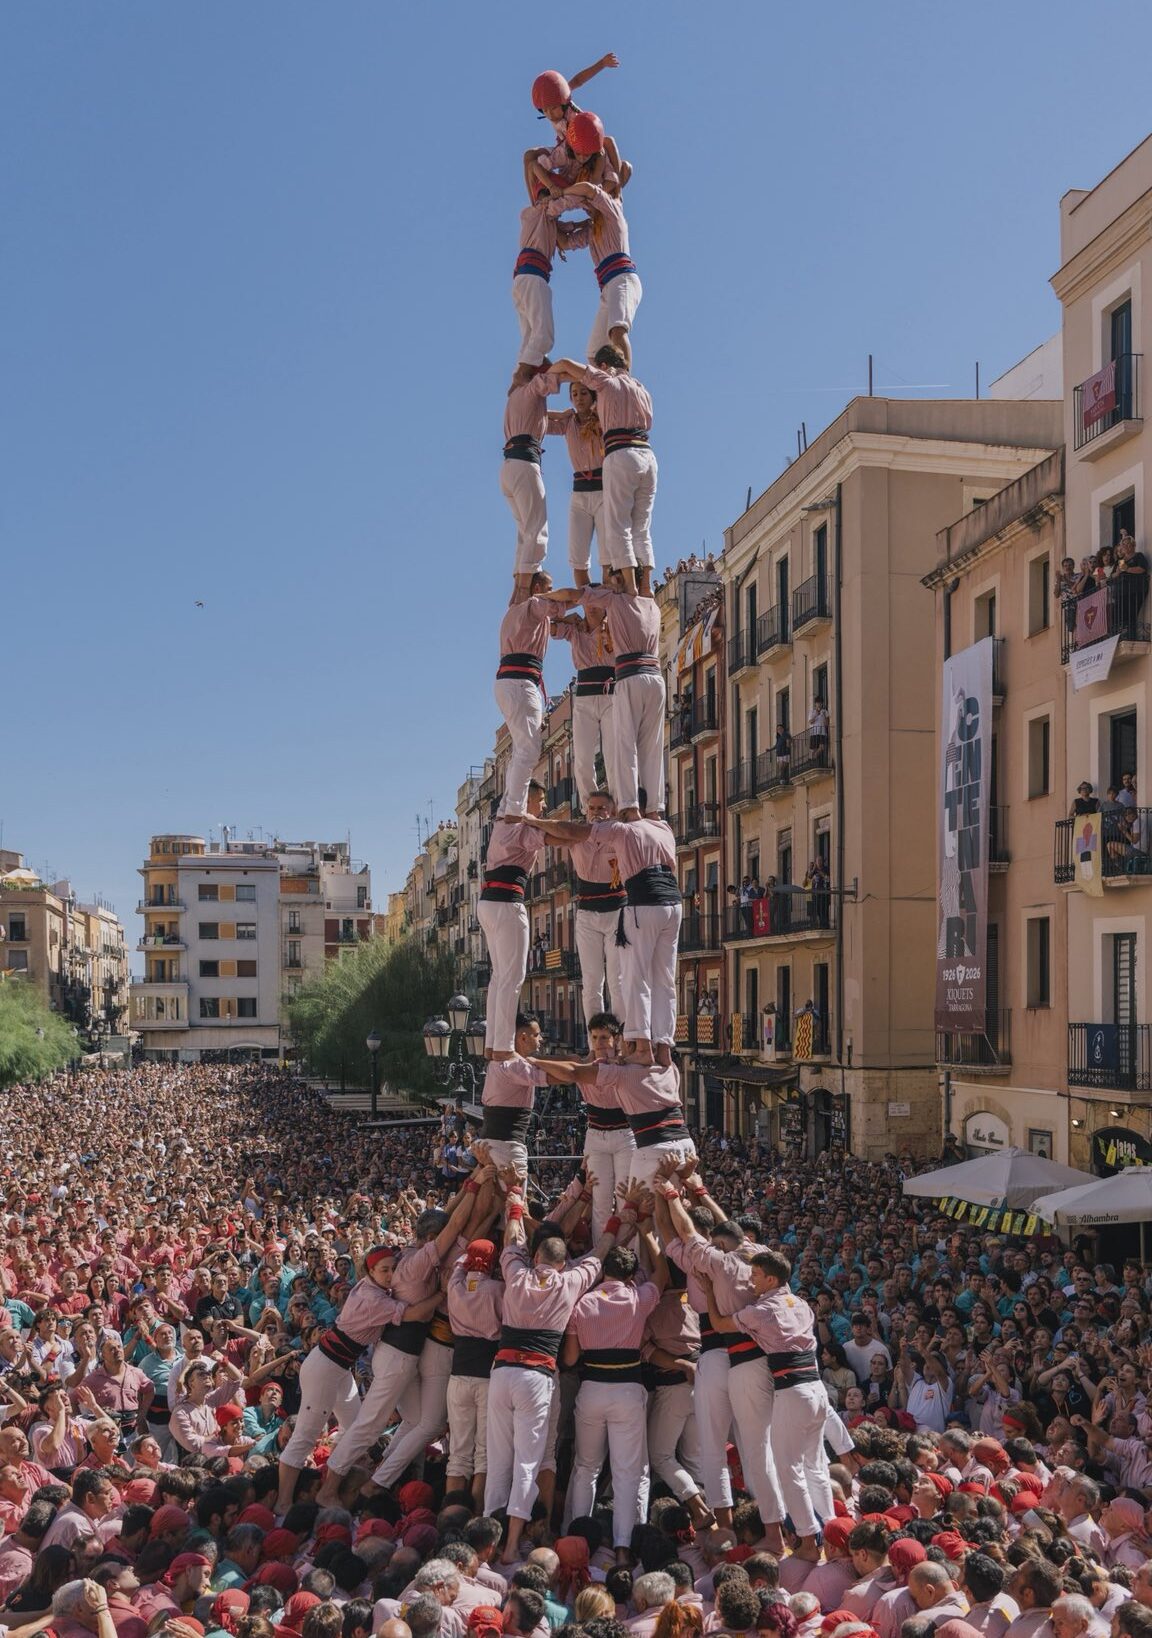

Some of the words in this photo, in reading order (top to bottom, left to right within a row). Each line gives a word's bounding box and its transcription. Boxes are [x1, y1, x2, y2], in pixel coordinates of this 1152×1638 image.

[943, 969, 956, 981] 1926
[965, 967, 981, 980] 2026
[947, 987, 974, 1002] XIQUETS
[1080, 1213, 1119, 1223] Alhambra
